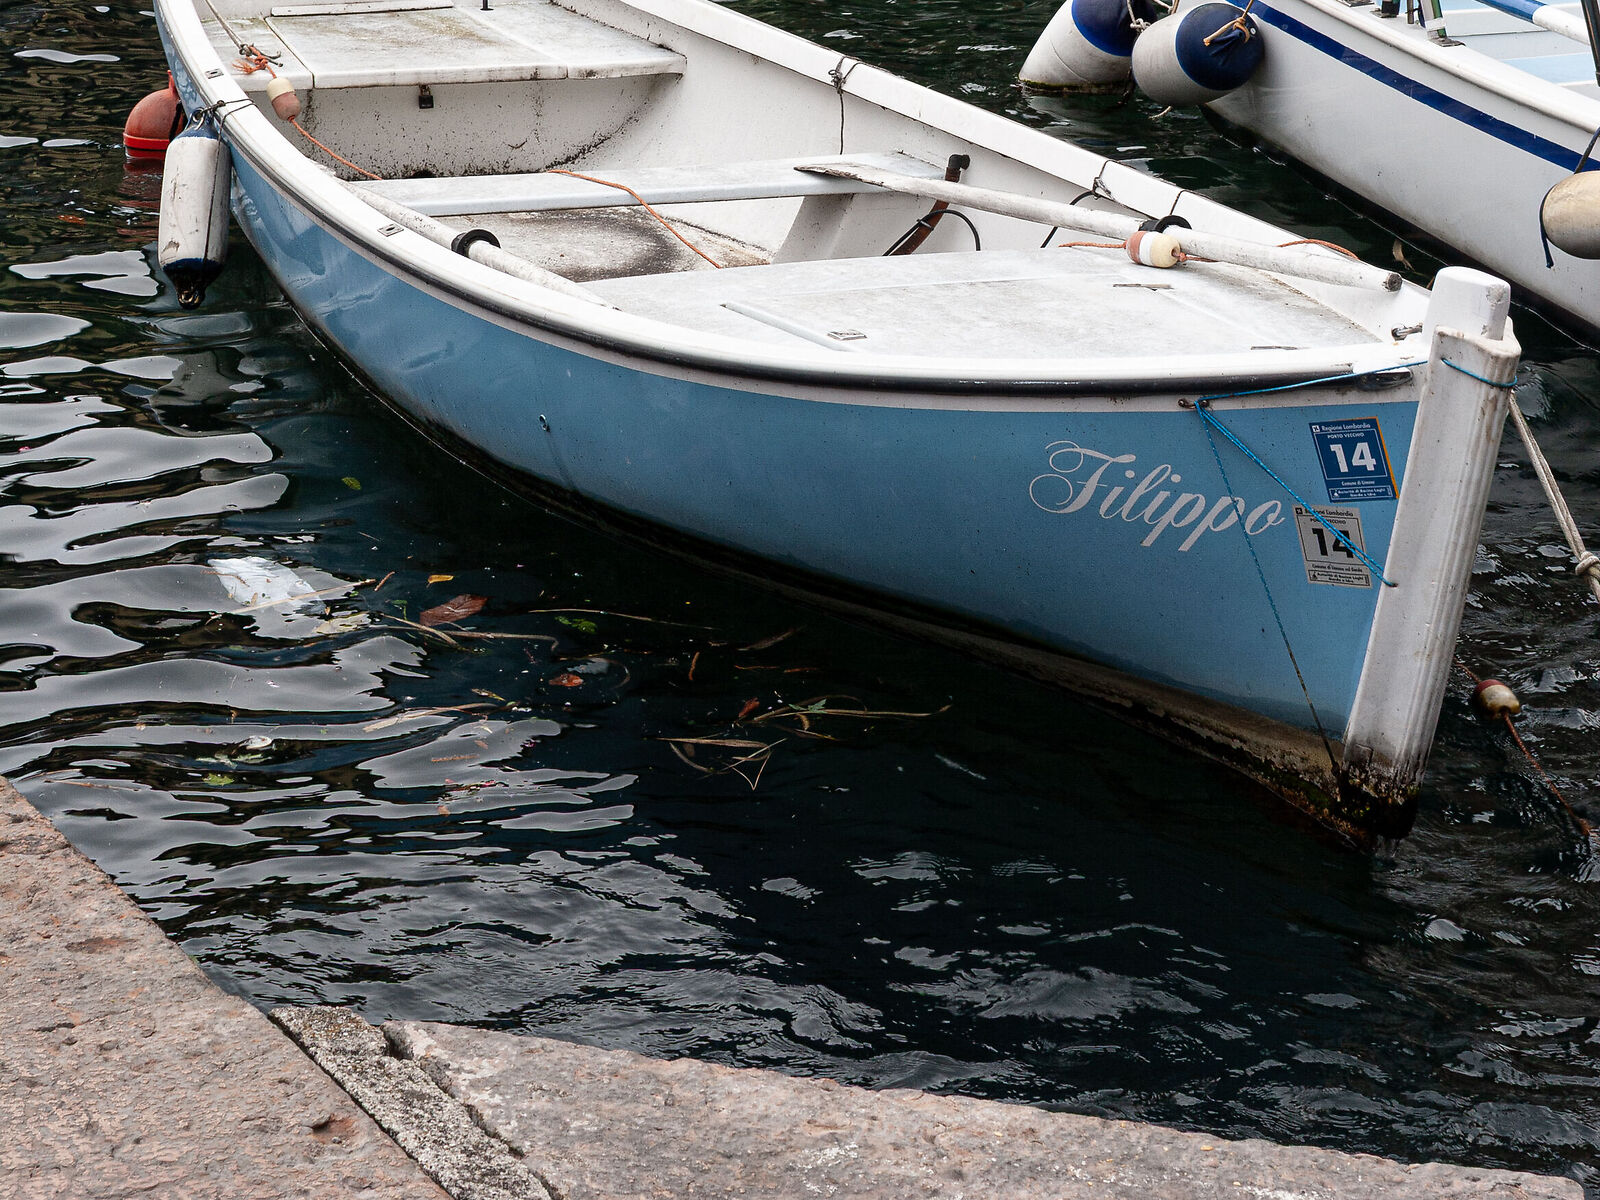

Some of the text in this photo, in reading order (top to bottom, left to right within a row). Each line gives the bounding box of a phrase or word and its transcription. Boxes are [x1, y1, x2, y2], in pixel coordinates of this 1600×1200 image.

[1343, 422, 1371, 430] Lombardia
[1329, 442, 1377, 473] 14
[1029, 440, 1286, 552] Filippo
[1325, 509, 1353, 517] Lombardia
[1312, 528, 1355, 558] 14
